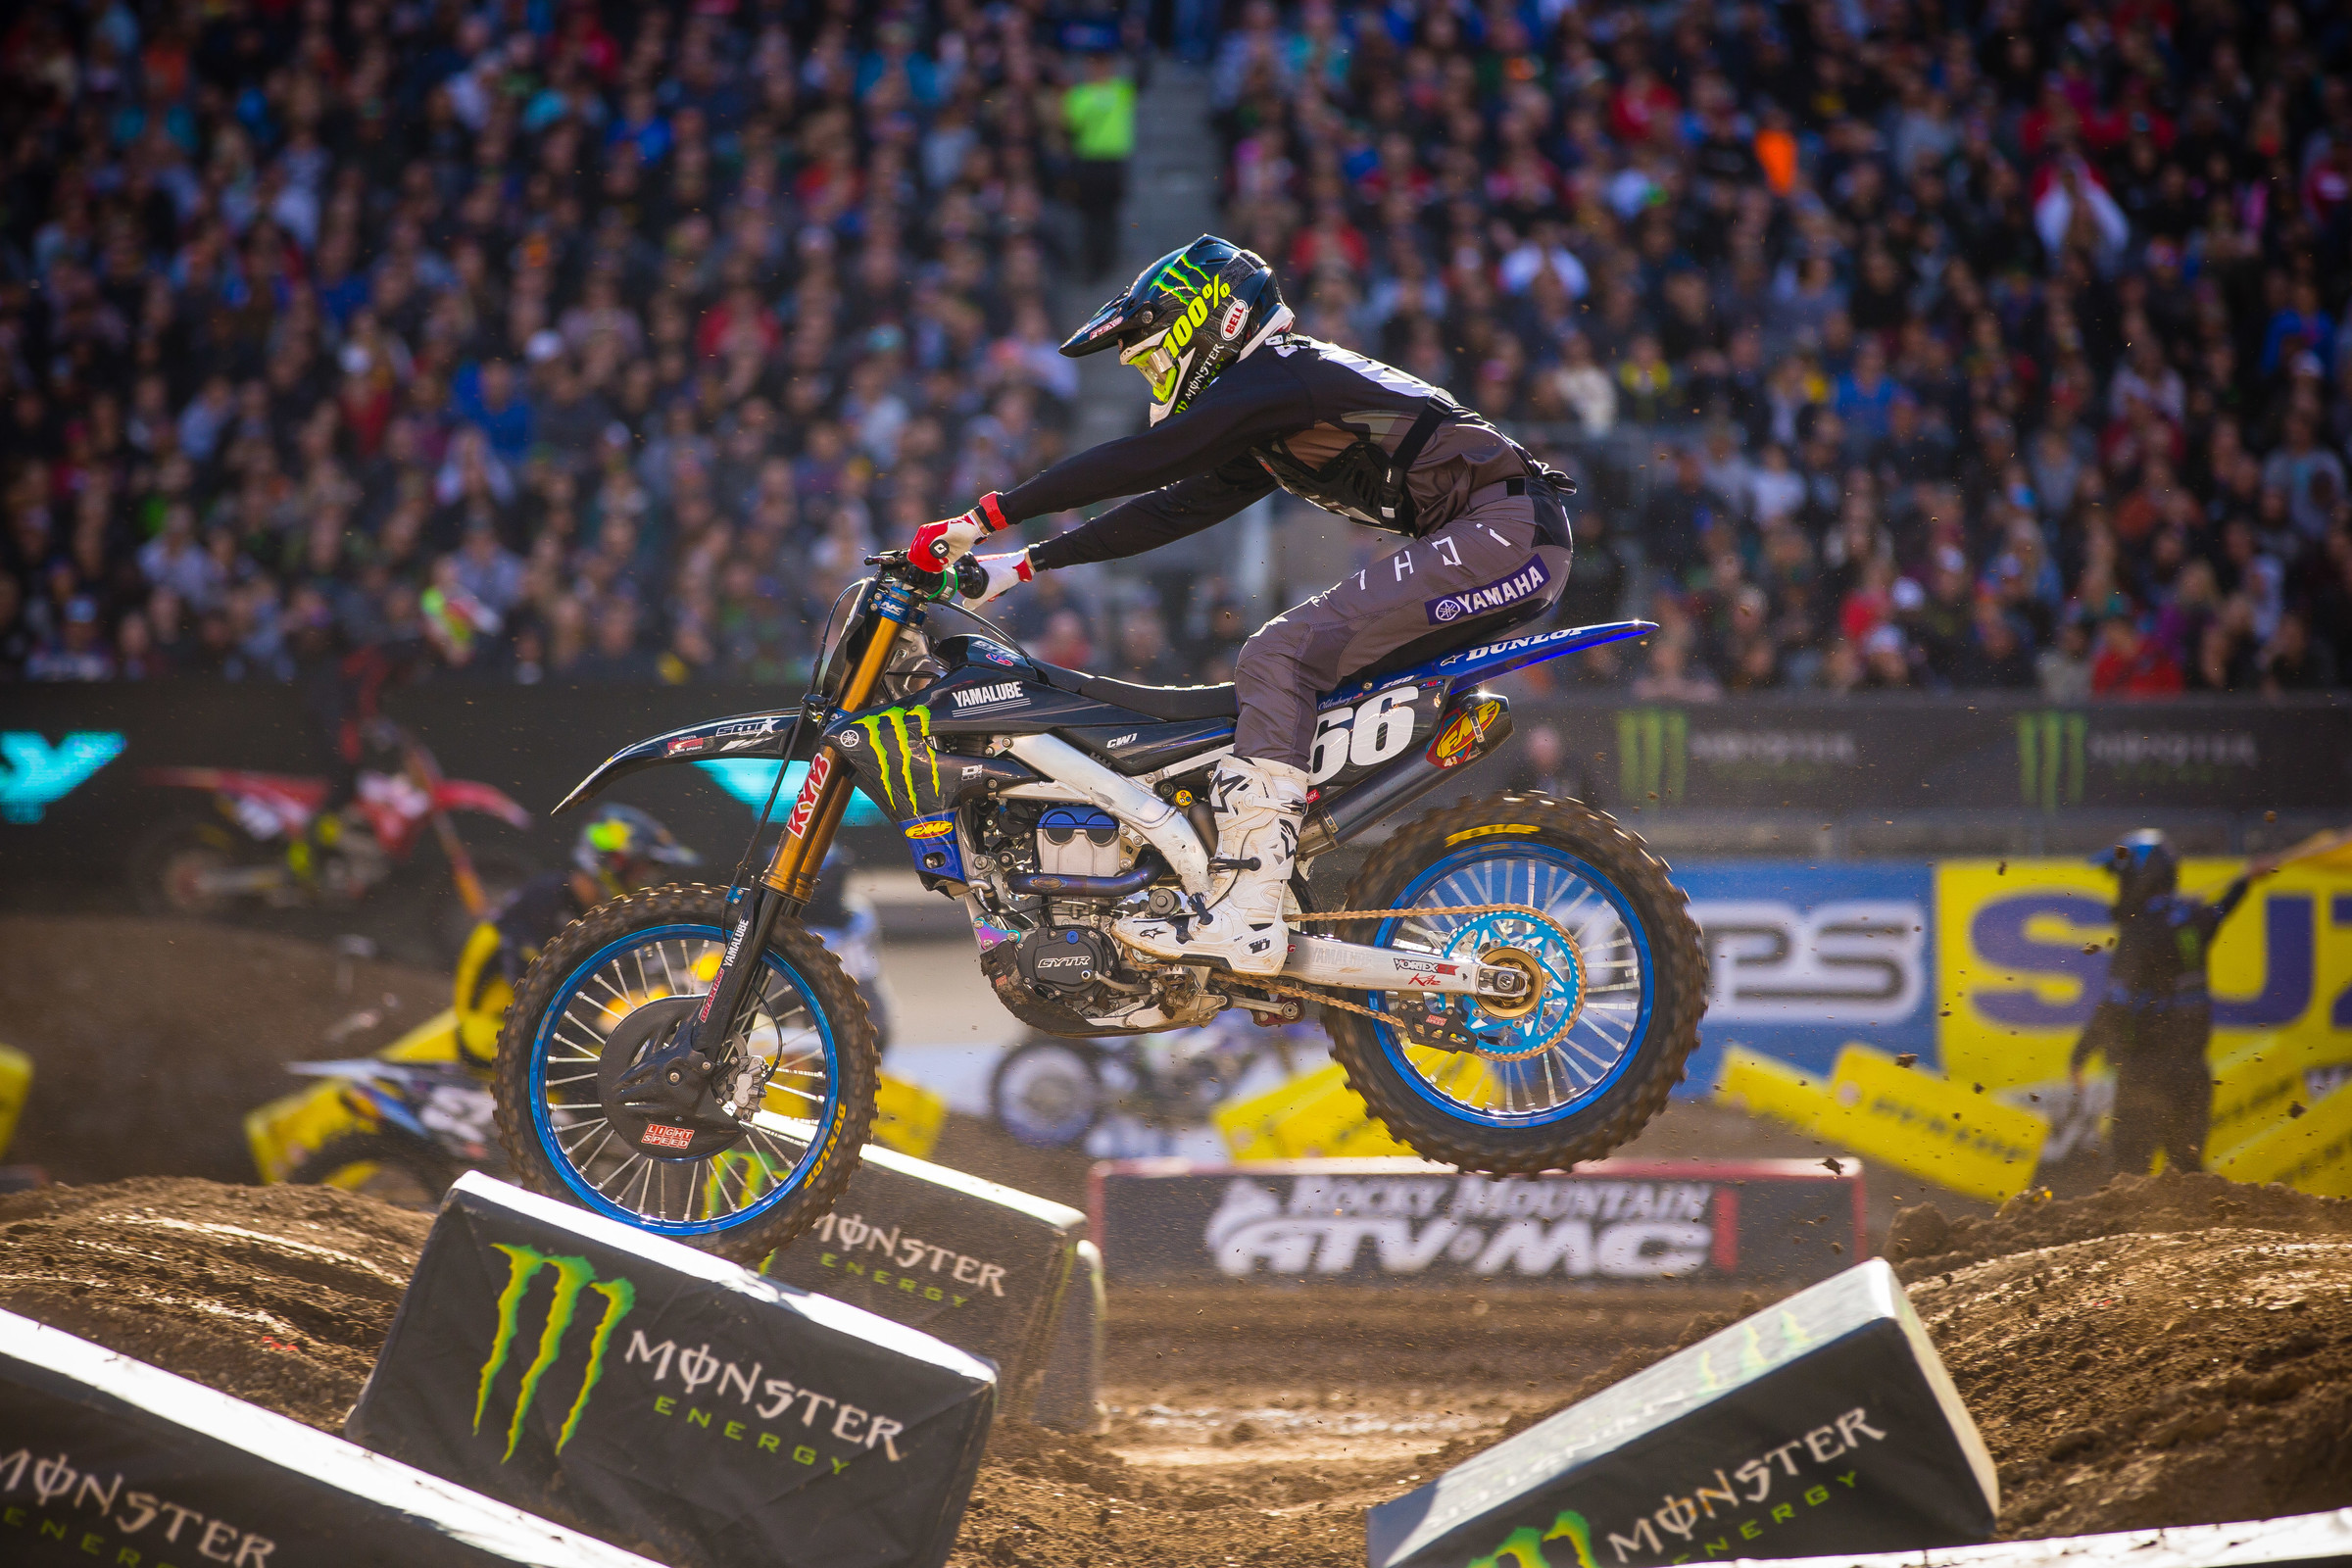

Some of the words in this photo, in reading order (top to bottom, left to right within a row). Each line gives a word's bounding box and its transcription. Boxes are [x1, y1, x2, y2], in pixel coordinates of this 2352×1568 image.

[1162, 273, 1231, 359] 100%
[1225, 307, 1245, 334] BELL
[1185, 343, 1225, 400] MONSTER
[1199, 357, 1225, 394] NERGY
[1456, 565, 1545, 614] YAMAHA
[952, 682, 1023, 708] YAMALUBE
[1379, 675, 1415, 690] 250
[1438, 699, 1497, 760] FMF
[787, 753, 831, 839] KYB
[906, 821, 954, 839] FMF
[722, 919, 750, 967] YAMALUBE
[1037, 956, 1091, 968] GYTR
[1393, 958, 1438, 973] VORTEX
[1968, 888, 2352, 1033] SU
[643, 1135, 688, 1147] SPEED
[648, 1125, 692, 1139] LIGHT
[804, 1101, 847, 1190] DUNLOP
[1456, 1178, 1711, 1221] MOUNTAIN
[820, 1251, 967, 1308] ENERGY
[624, 1329, 905, 1462] MONSTER
[653, 1395, 850, 1475] ENERGY
[1607, 1407, 1887, 1564] MONSTER
[4, 1505, 177, 1568] ENER
